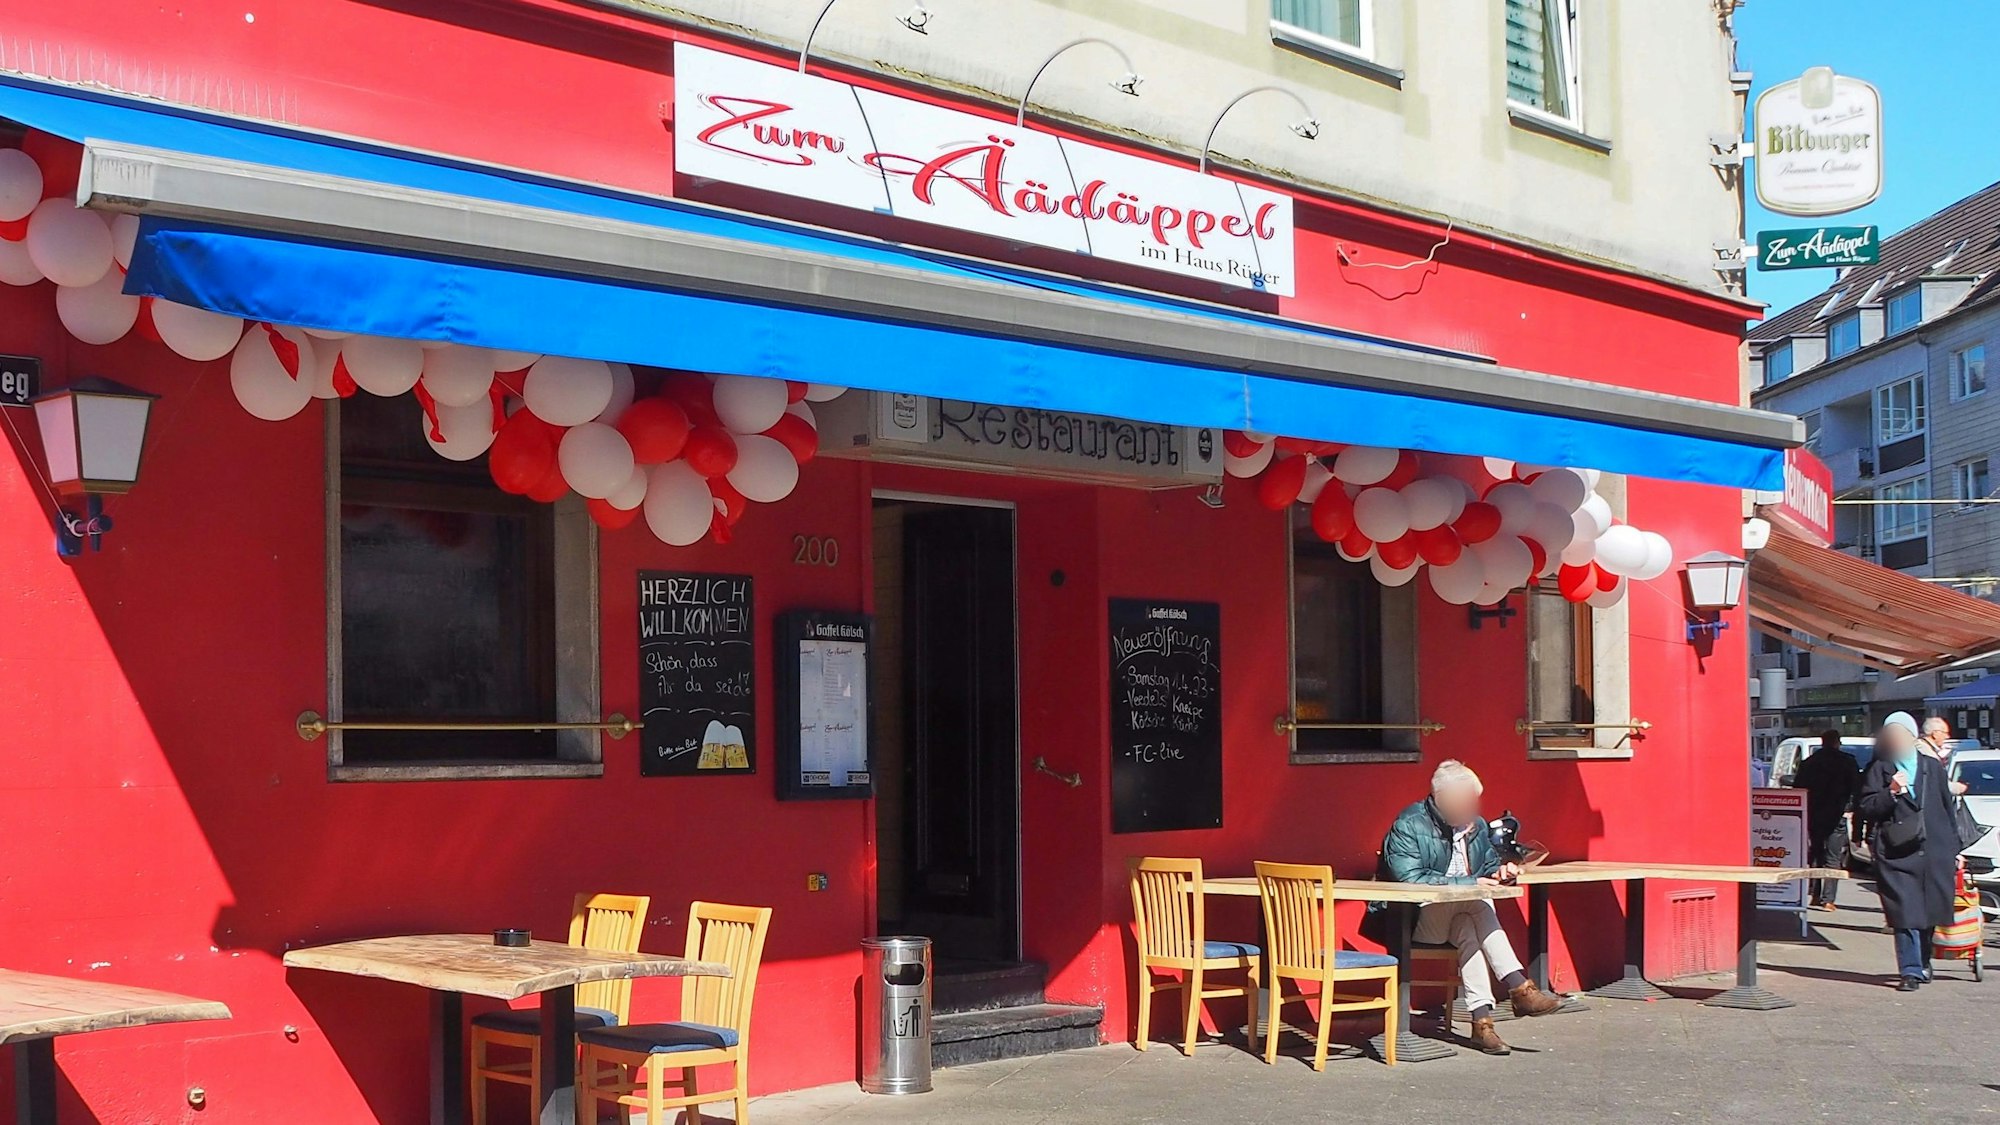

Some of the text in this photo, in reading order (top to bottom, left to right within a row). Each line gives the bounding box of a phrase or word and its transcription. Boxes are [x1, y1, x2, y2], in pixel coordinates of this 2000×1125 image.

[1766, 124, 1870, 155] Bitburger
[696, 92, 1277, 249] Zum Aädäppel
[1141, 240, 1280, 287] im Haus Rüger
[1765, 238, 1797, 266] Zum
[932, 398, 1178, 466] Restaurant
[794, 535, 839, 567] 200
[641, 577, 746, 606] HERZLICH
[640, 607, 750, 638] WILLKOMMEN
[816, 624, 864, 639] Gaffel Kölsch
[690, 651, 718, 668] dass
[1113, 626, 1211, 664] Neueröffnung
[658, 675, 675, 696] ihr
[685, 675, 703, 692] da
